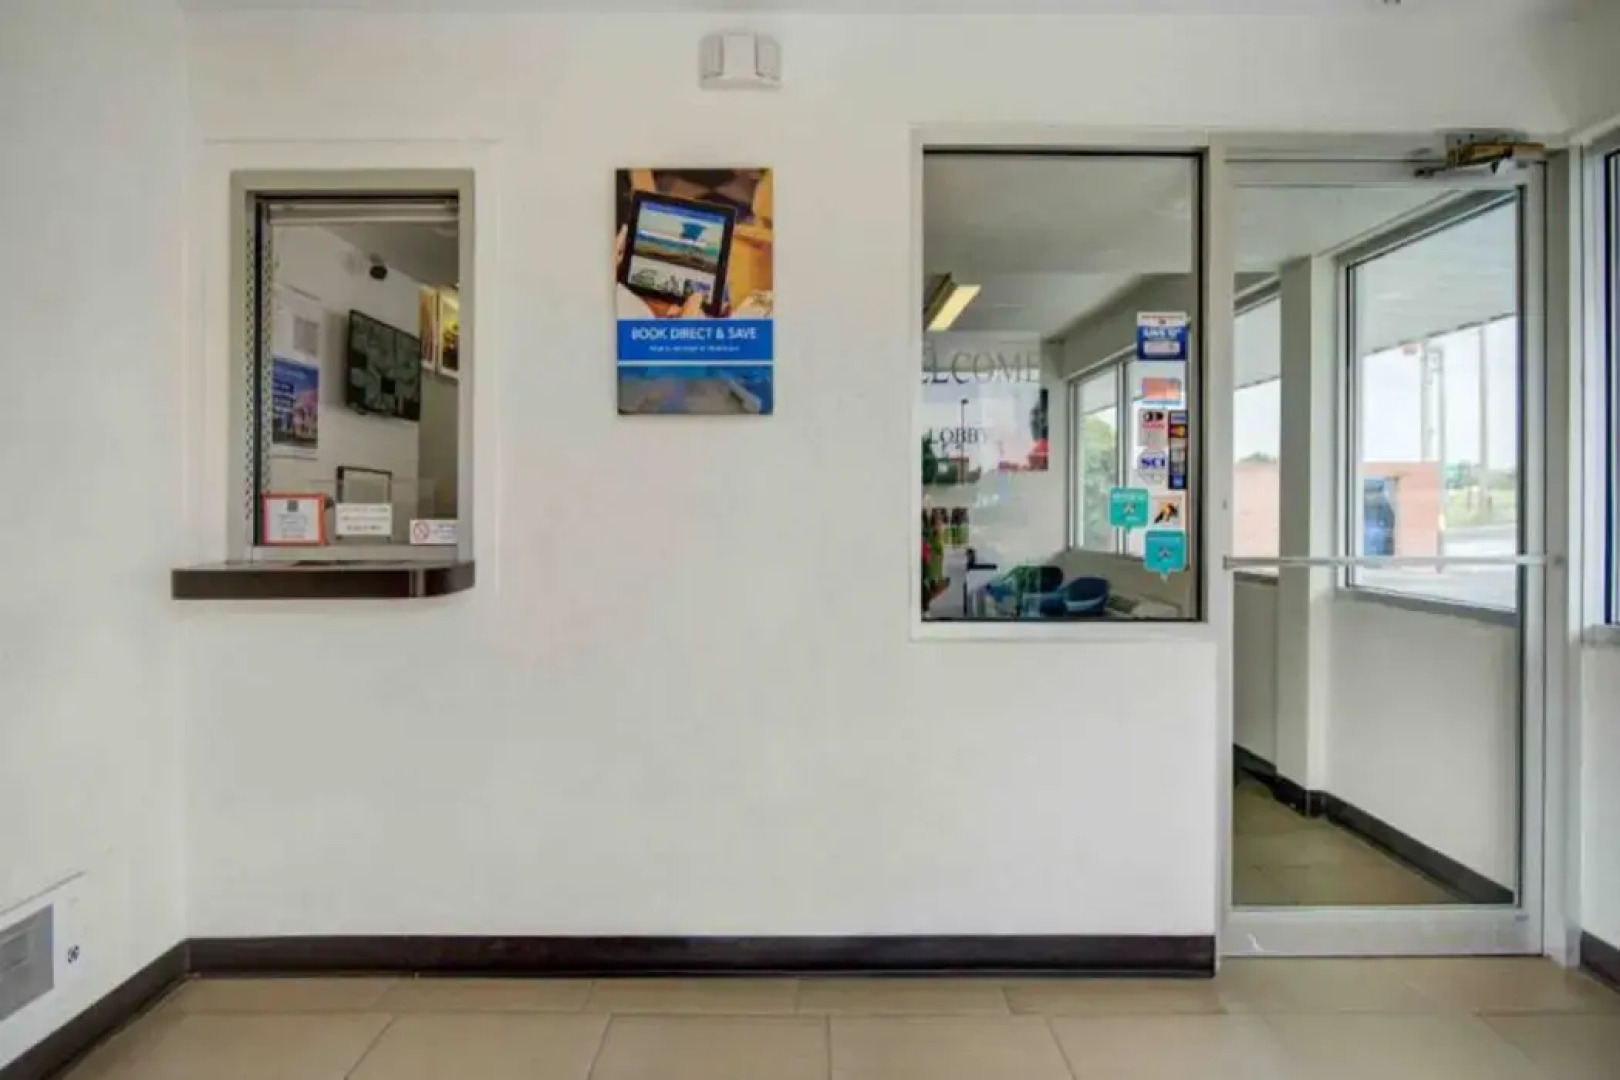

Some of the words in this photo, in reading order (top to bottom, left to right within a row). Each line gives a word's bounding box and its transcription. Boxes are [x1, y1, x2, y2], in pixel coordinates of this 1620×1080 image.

[631, 327, 667, 340] BOOK
[670, 327, 712, 340] DIRECT
[715, 327, 725, 340] &
[728, 326, 757, 339] SAVE
